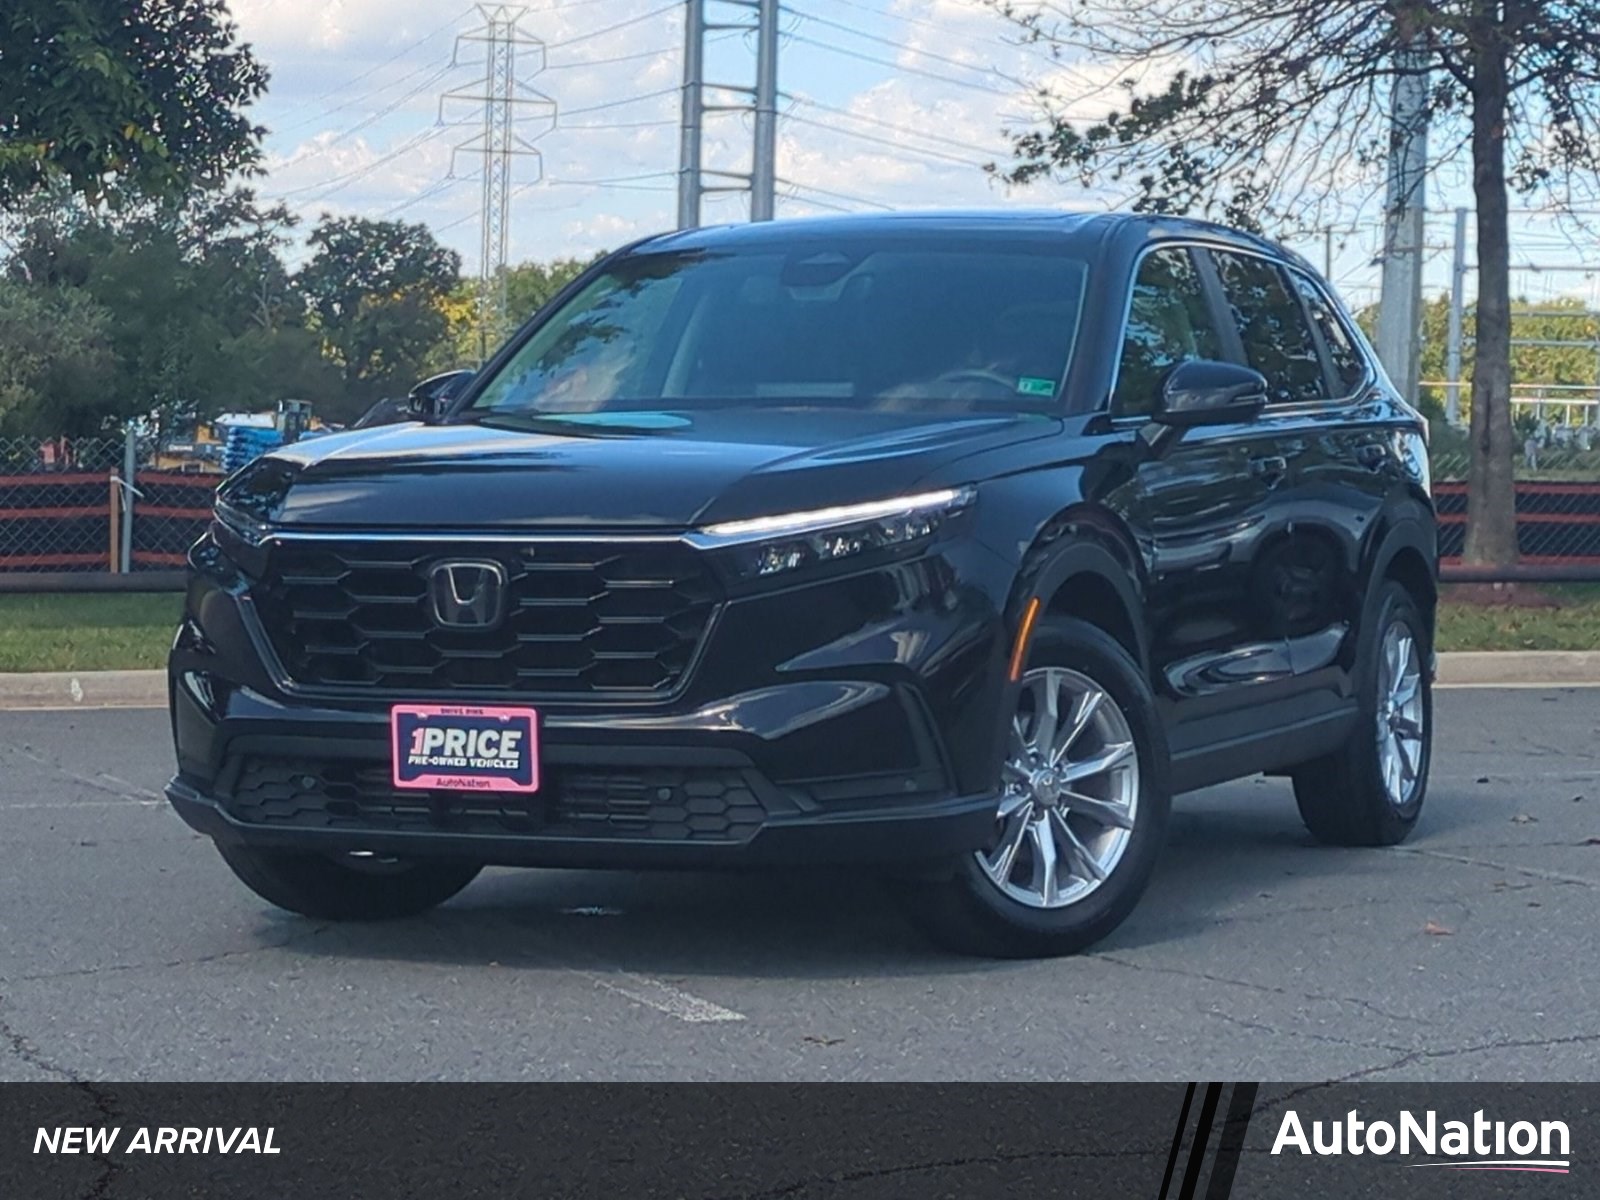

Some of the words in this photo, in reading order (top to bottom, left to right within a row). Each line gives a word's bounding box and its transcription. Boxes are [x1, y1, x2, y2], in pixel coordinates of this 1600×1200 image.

[408, 755, 468, 768] PRE-OWNED
[470, 757, 519, 769] VEHICLES
[436, 778, 491, 789] AutoNation
